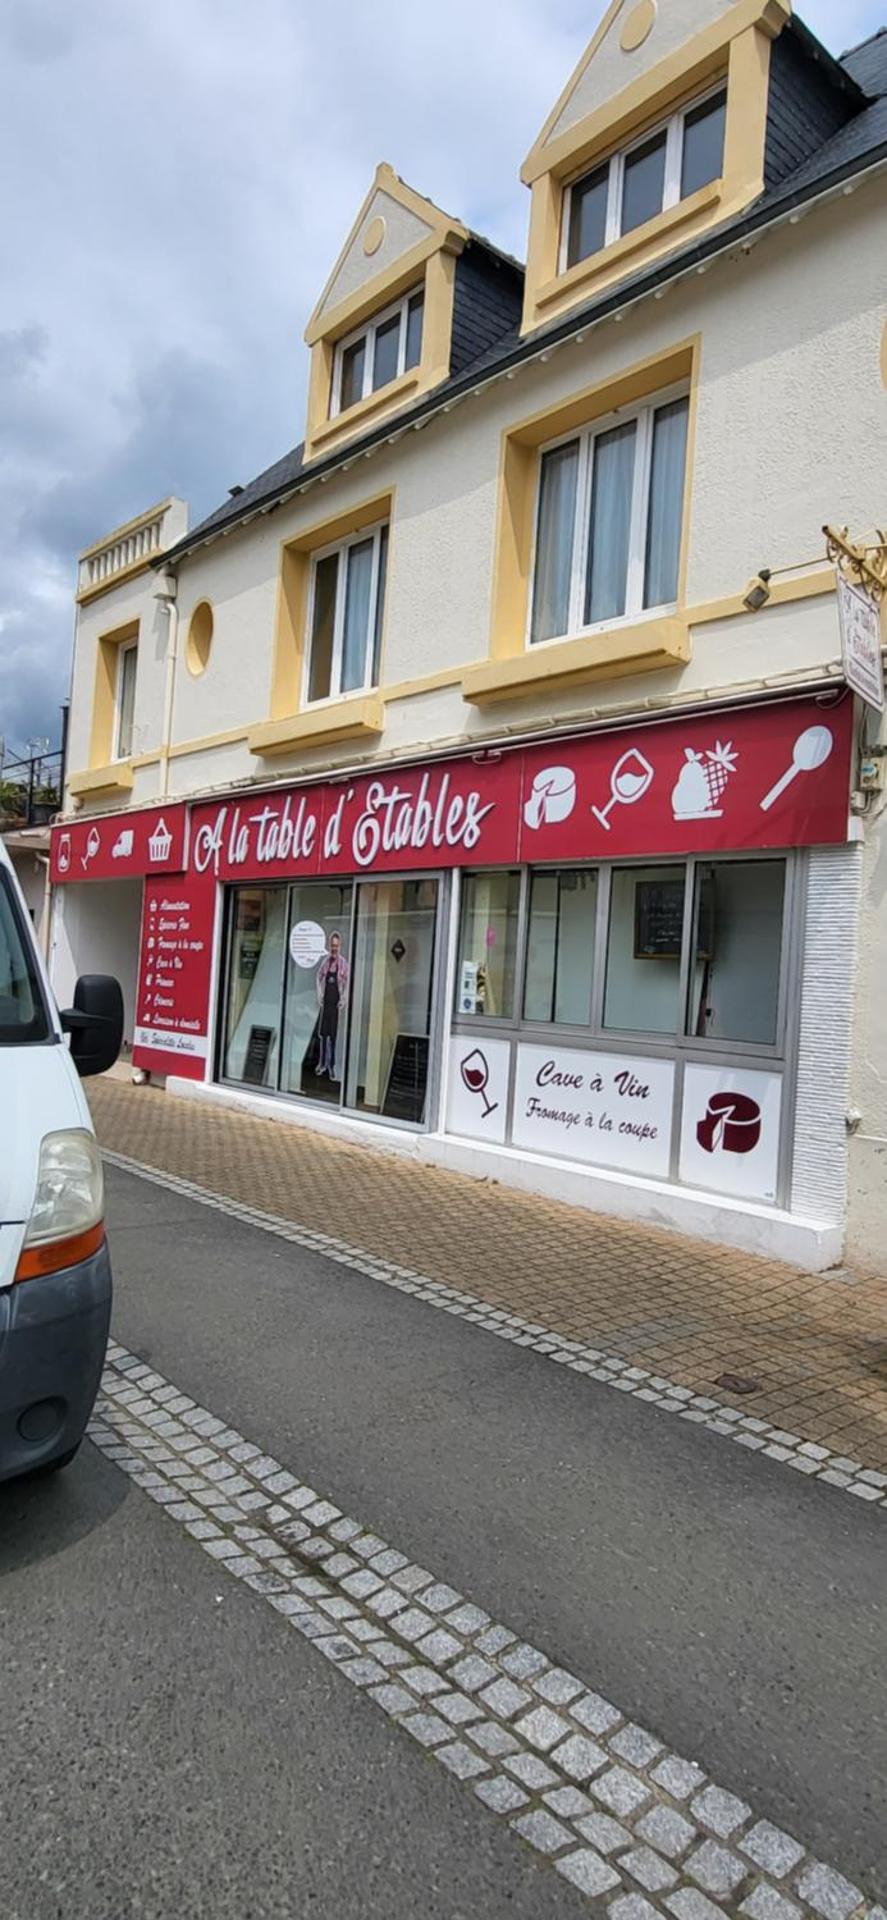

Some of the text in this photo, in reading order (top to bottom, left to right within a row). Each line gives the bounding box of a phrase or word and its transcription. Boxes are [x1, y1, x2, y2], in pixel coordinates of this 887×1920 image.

[194, 807, 227, 875] A
[228, 807, 249, 864] la
[249, 796, 317, 862] table
[536, 1060, 651, 1100] Cave à Vin
[525, 1097, 659, 1141] Fromage à la coupe
